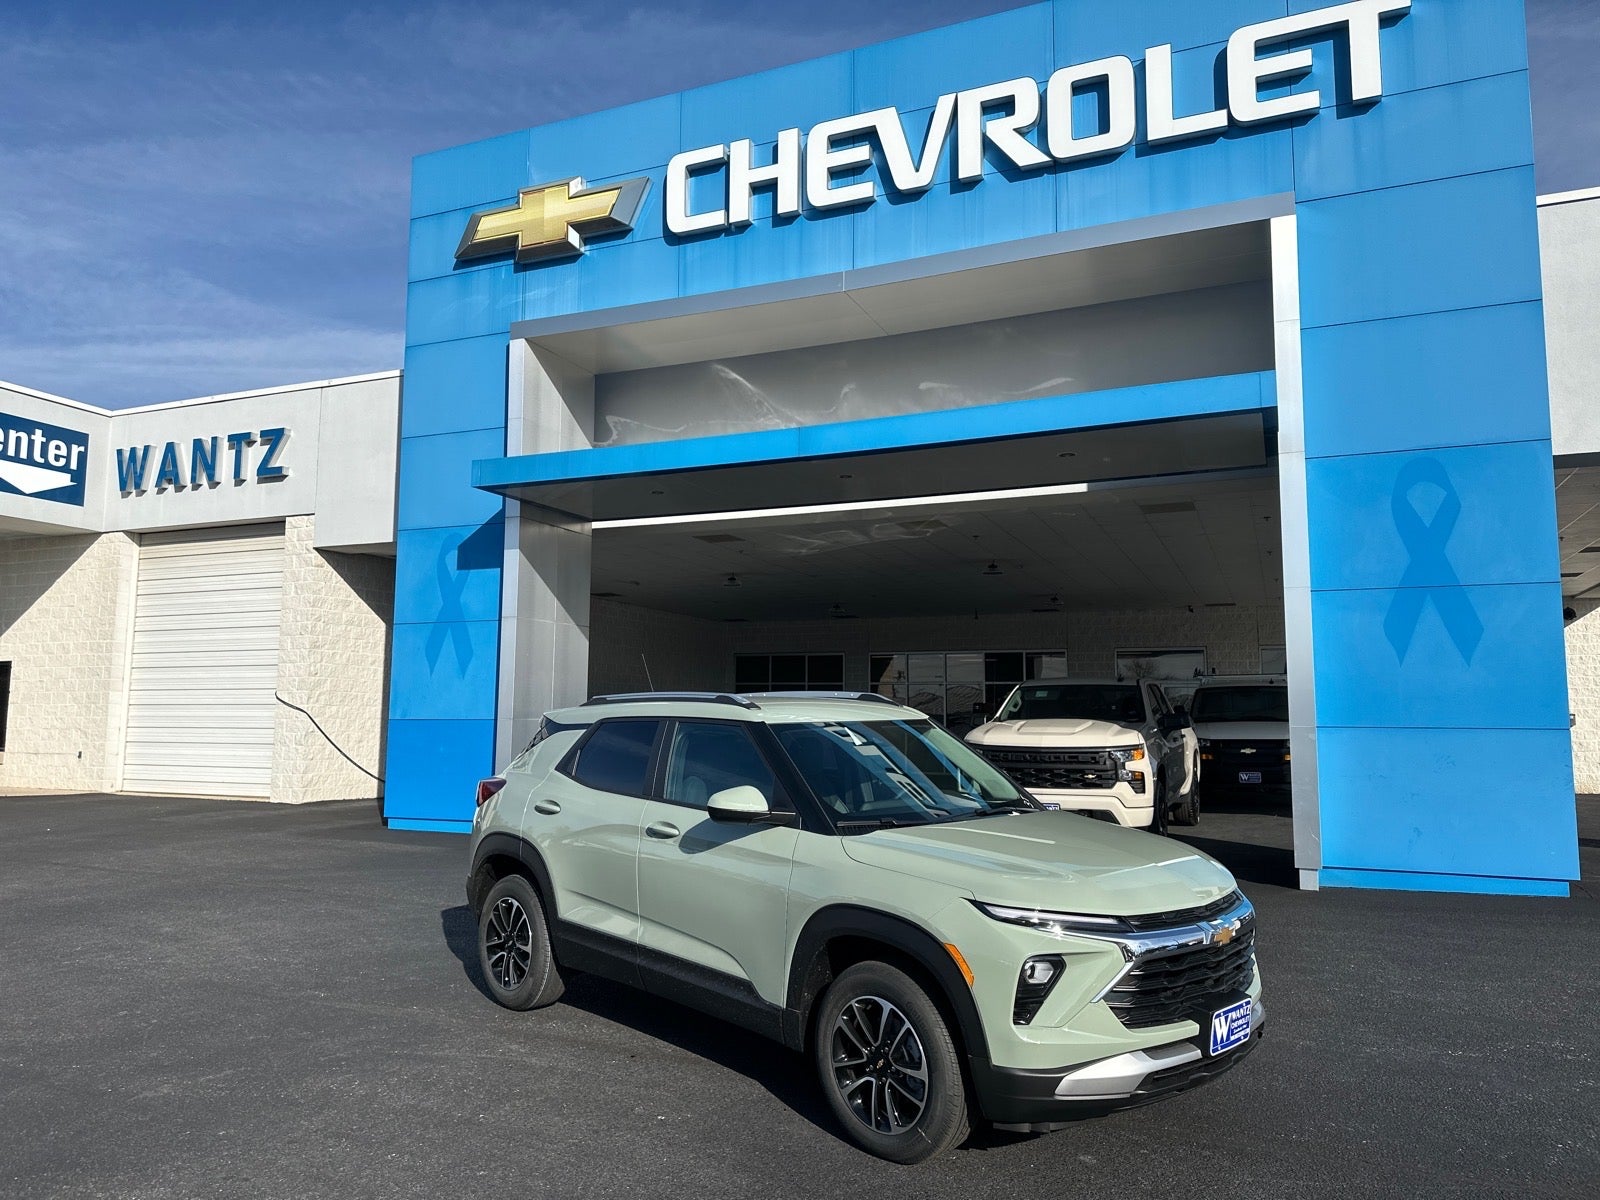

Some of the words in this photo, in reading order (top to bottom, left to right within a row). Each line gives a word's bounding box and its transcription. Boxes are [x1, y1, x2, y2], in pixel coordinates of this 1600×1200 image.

[665, 0, 1411, 237] CHEVROLET
[0, 427, 85, 471] nter
[116, 427, 290, 496] WANTZ
[1213, 1013, 1232, 1045] W
[1231, 1005, 1250, 1020] WANTZ
